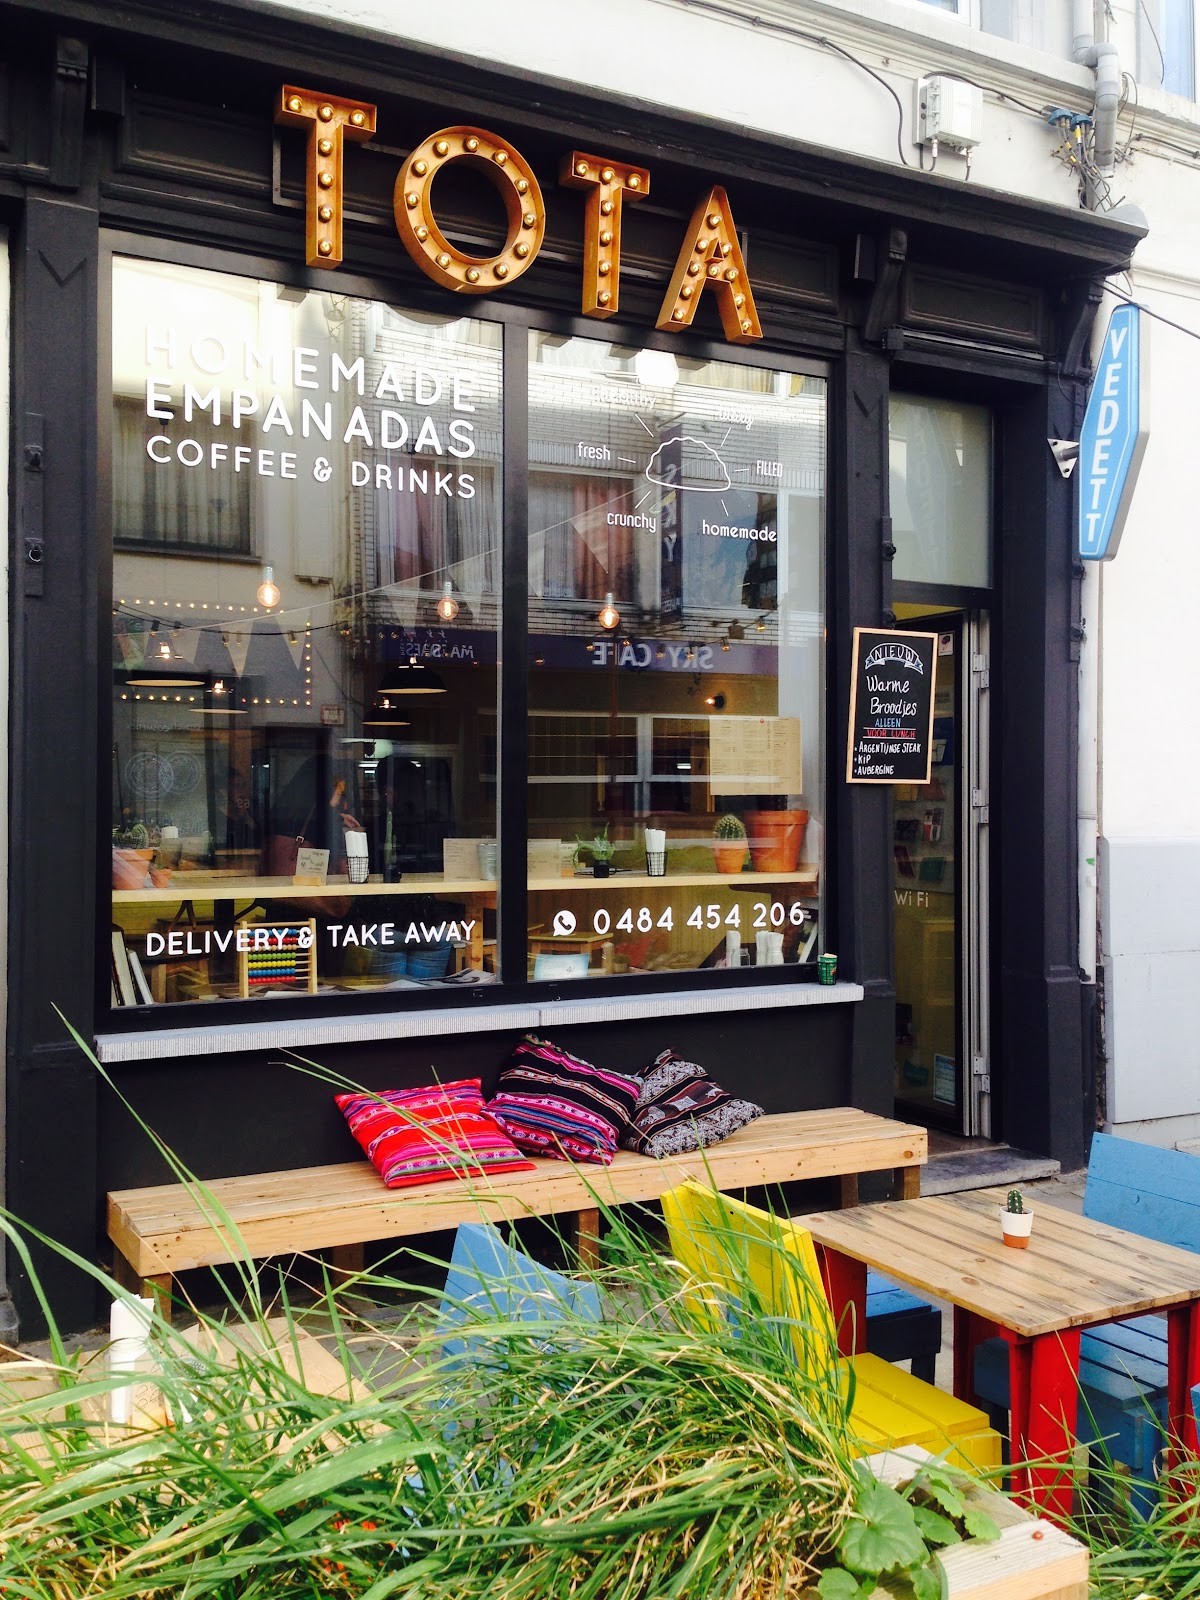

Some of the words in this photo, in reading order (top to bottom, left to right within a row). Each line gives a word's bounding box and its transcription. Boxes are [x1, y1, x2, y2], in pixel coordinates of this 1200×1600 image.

[274, 84, 764, 344] TOTA
[145, 321, 477, 413] HOMEMADE
[145, 375, 477, 459] EMPANADAS
[1085, 326, 1129, 543] VEDETT
[577, 441, 611, 461] fresh
[145, 434, 298, 480] COFFEE
[313, 455, 333, 483] &
[351, 460, 477, 500] DRINKS
[756, 459, 784, 478] FILLED
[606, 511, 657, 533] crunchy
[702, 518, 778, 543] homemade
[874, 645, 914, 662] NIEUW
[866, 674, 910, 694] Warme
[870, 696, 918, 718] Broodjes
[866, 729, 887, 738] VOOR
[891, 729, 916, 738] LUNCH
[874, 717, 901, 728] ALLEEN
[901, 742, 922, 754] STEAK
[593, 905, 674, 935] 0484
[686, 903, 741, 930] 454
[752, 901, 805, 928] 206
[145, 926, 290, 957] DELIVERY
[297, 926, 315, 949] &
[326, 922, 396, 948] TAKE
[404, 919, 477, 944] AWAY
